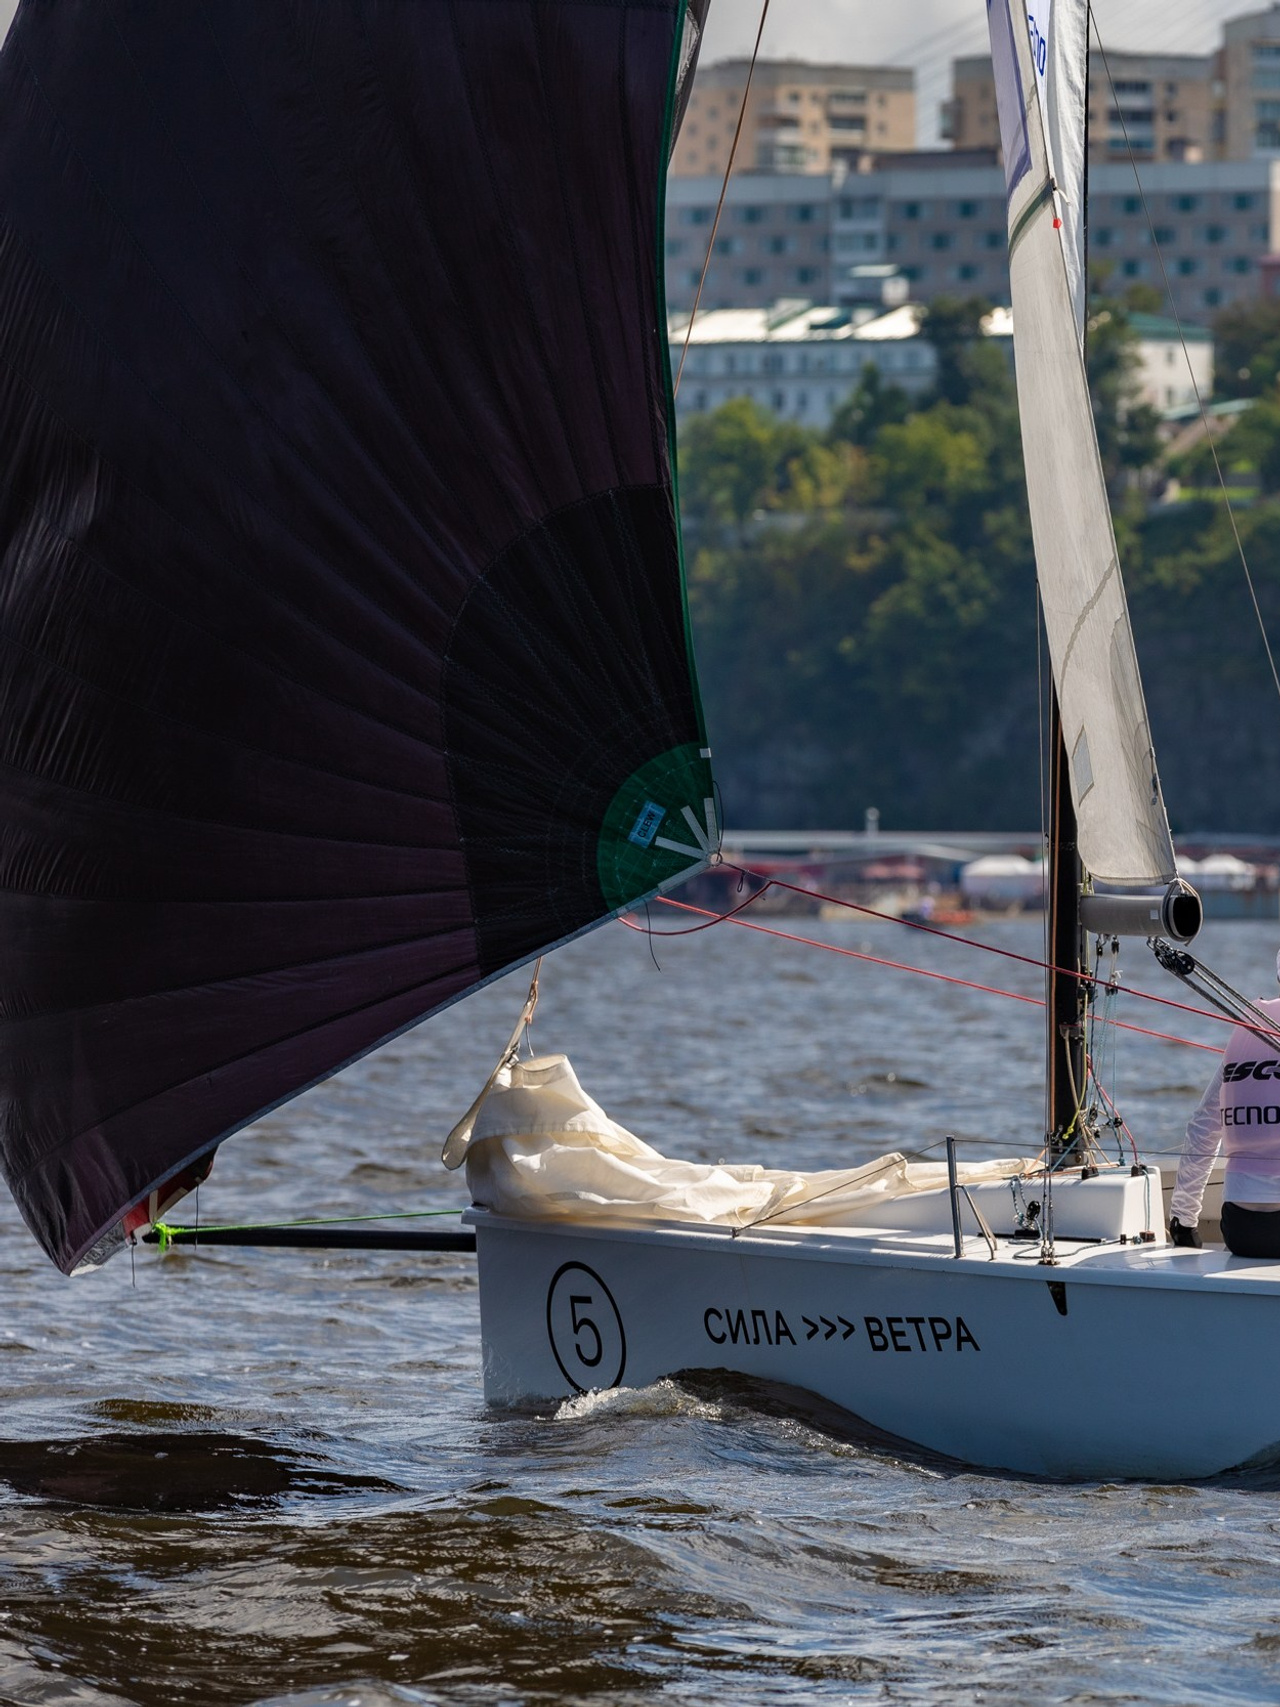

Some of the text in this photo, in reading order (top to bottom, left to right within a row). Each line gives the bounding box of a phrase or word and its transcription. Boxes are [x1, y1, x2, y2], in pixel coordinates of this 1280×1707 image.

[637, 810, 656, 838] CLEW
[569, 1295, 603, 1368] 5
[703, 1307, 982, 1352] СИЛА ВЕТРА
